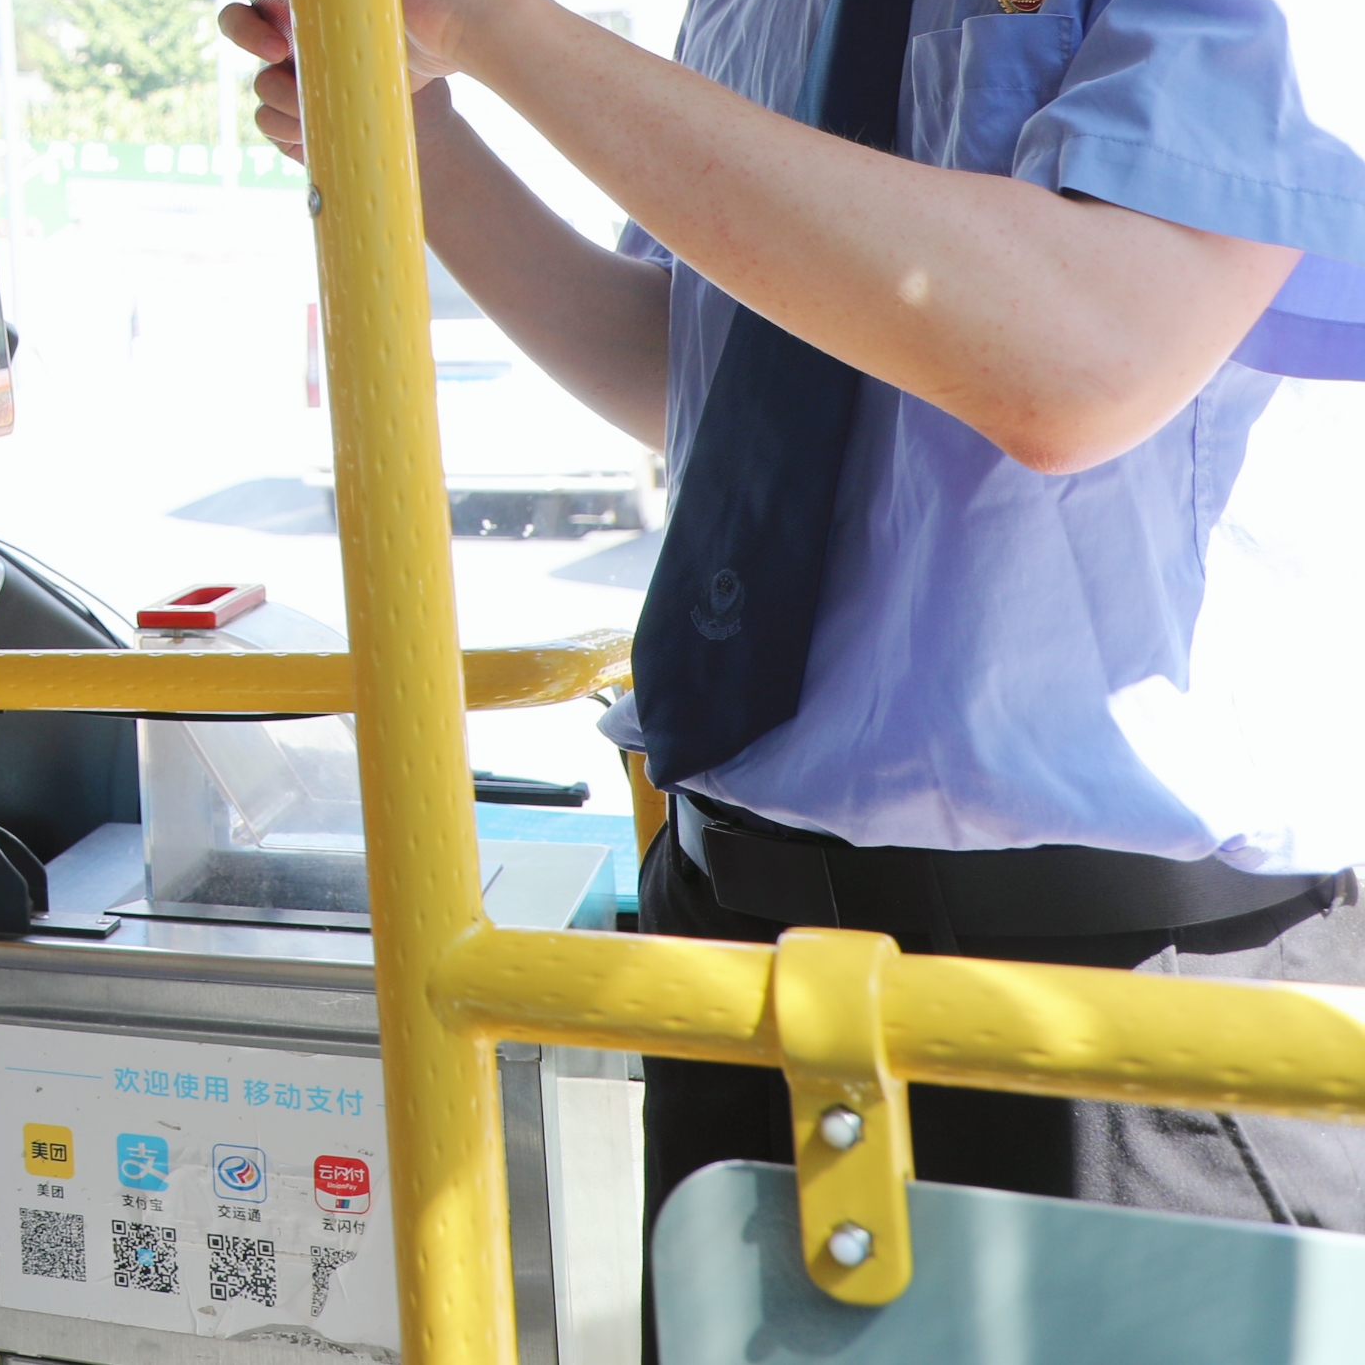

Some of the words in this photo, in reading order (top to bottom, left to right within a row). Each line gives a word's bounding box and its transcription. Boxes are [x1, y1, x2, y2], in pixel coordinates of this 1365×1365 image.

[114, 1067, 230, 1104] 欢迎使用
[243, 1078, 364, 1117] 移动支付
[31, 1140, 68, 1163] 美团
[318, 1164, 366, 1183] 云闪付
[37, 1183, 64, 1200] 美团
[326, 1181, 358, 1192] UnionPay
[121, 1193, 164, 1212] 支付宝
[217, 1204, 262, 1223] 交运通
[322, 1217, 366, 1236] 云闪付
